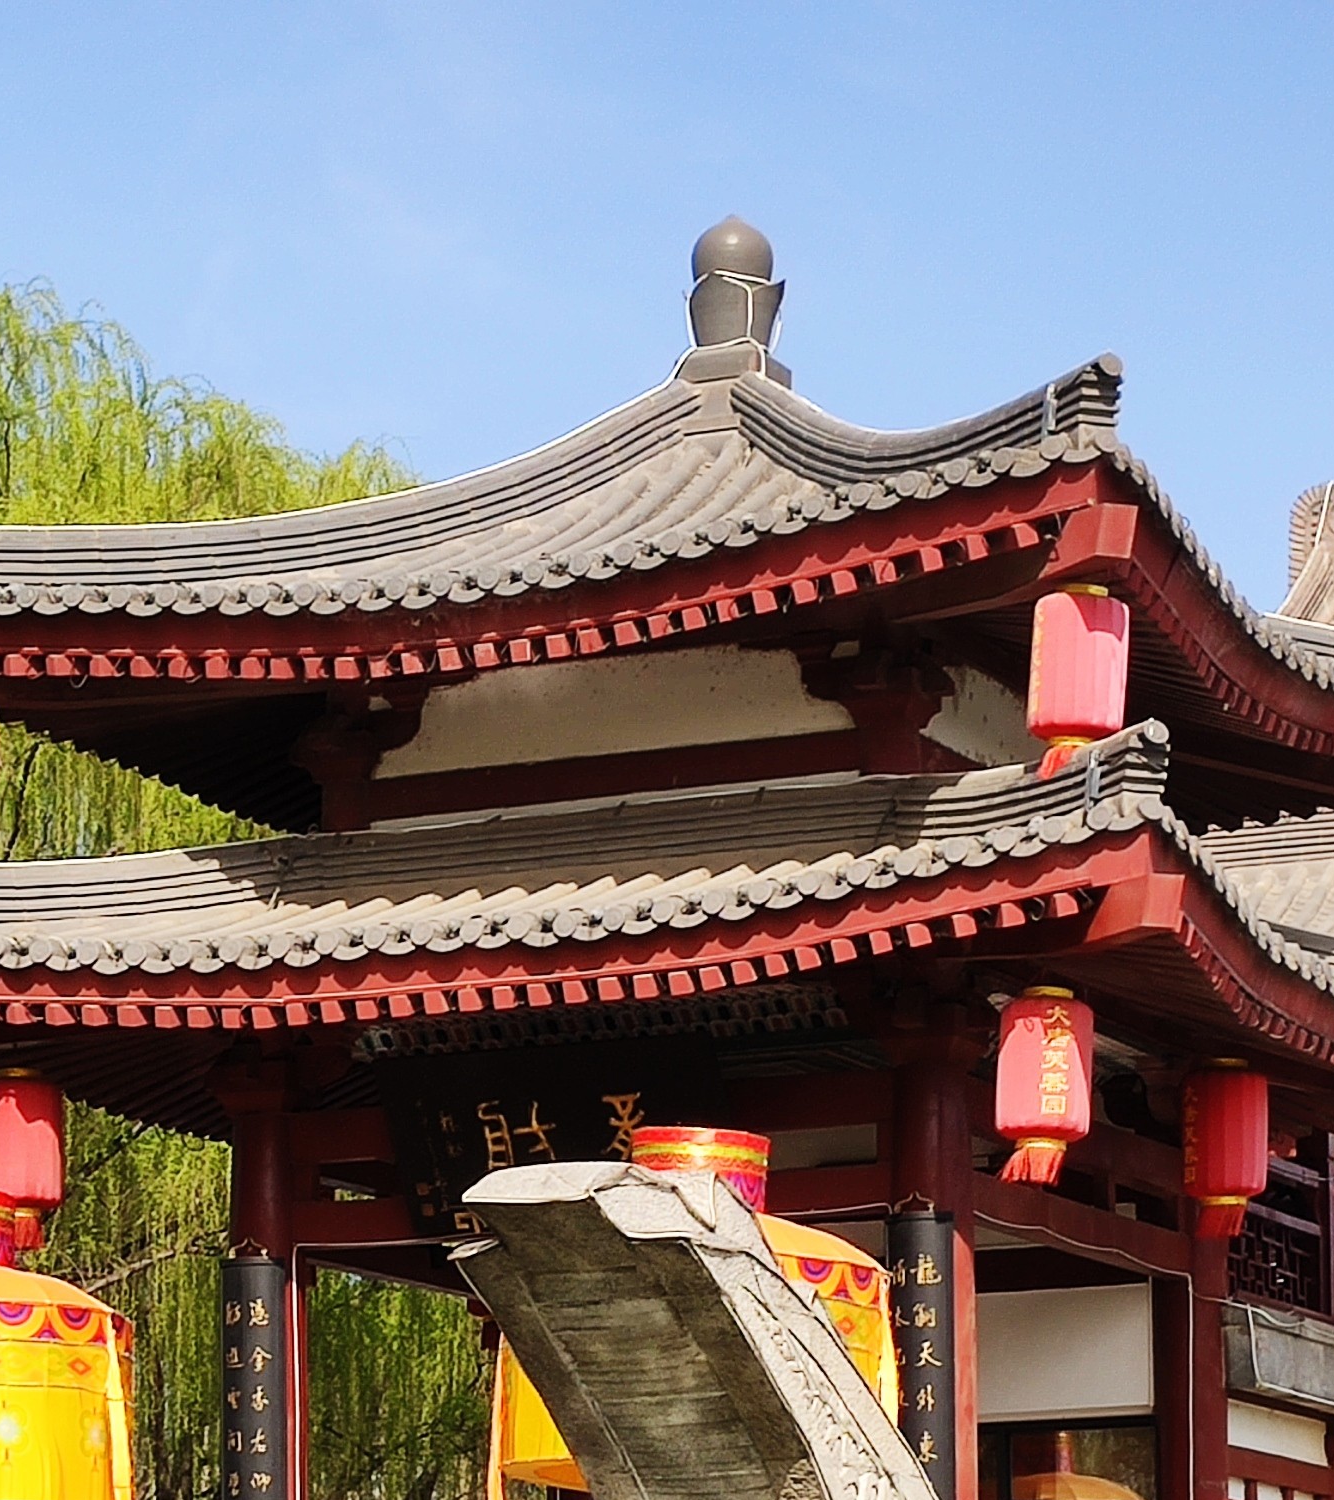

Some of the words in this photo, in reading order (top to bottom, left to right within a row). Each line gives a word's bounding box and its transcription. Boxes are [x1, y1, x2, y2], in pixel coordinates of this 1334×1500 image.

[1039, 1005, 1072, 1115] 大唐芙蓉园
